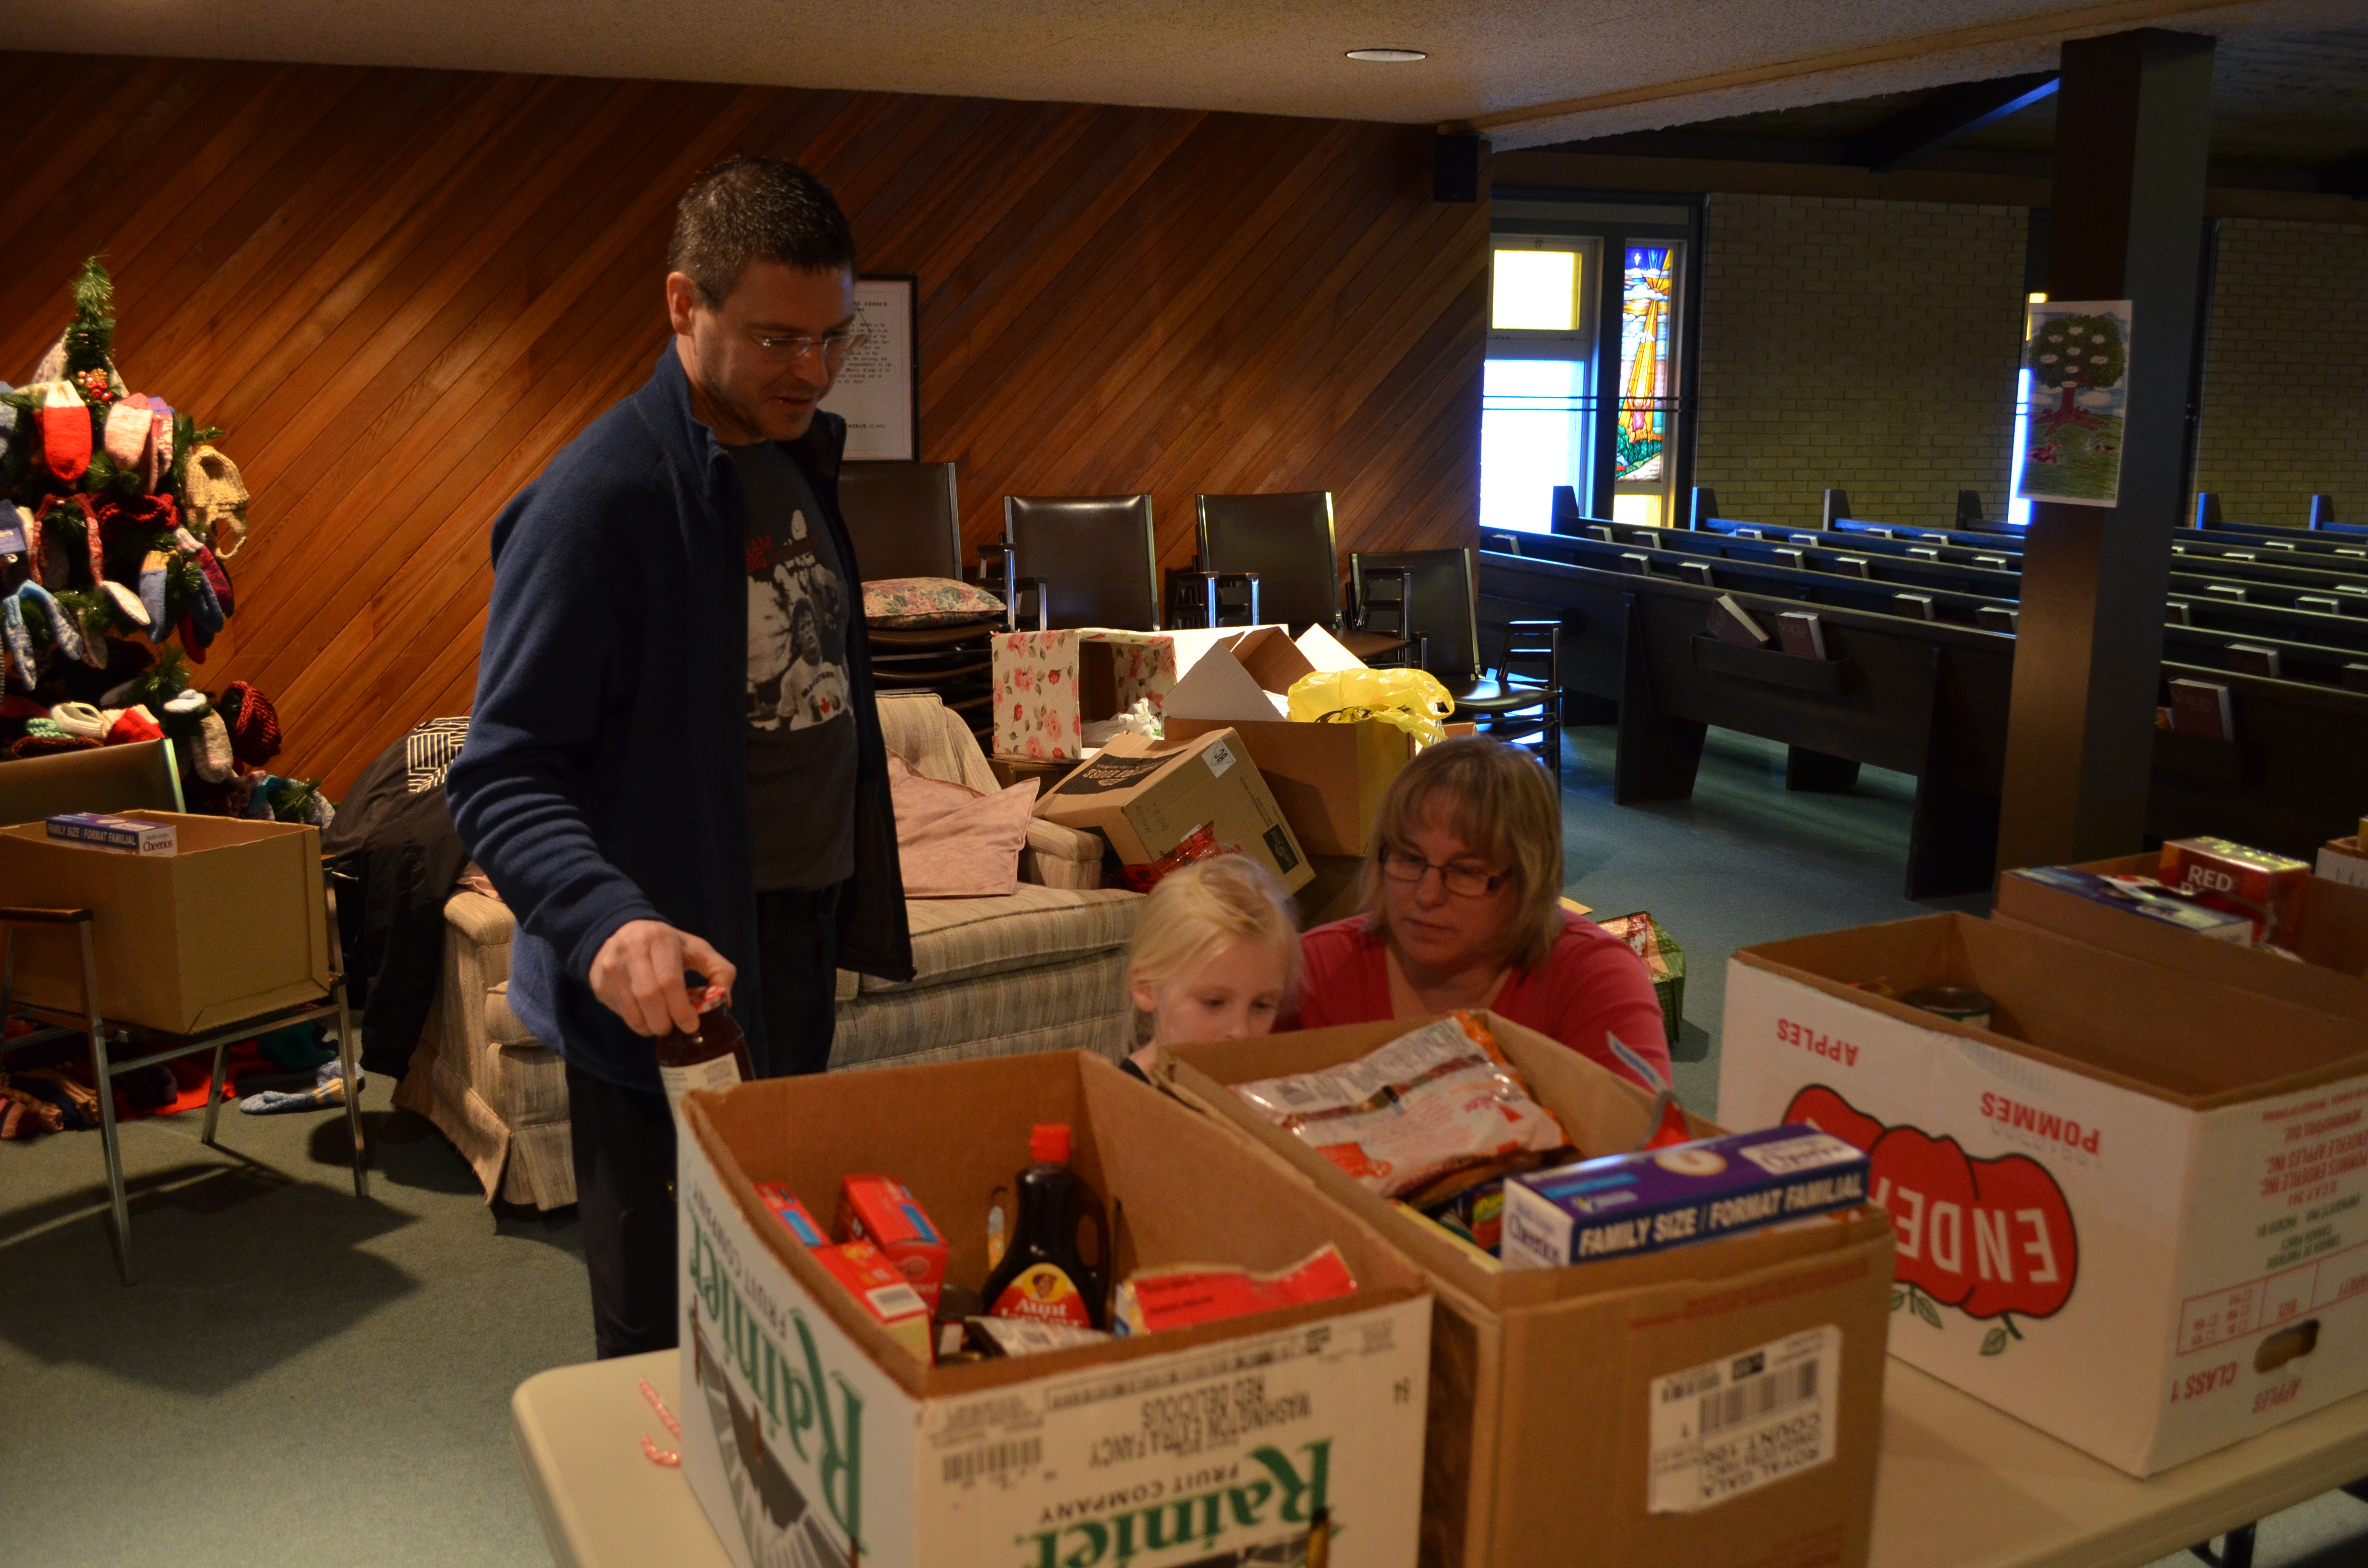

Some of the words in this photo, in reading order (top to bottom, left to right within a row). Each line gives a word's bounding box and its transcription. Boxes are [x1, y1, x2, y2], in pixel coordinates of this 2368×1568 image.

[48, 823, 67, 837] FAMILY
[67, 825, 80, 837] SIZE
[84, 830, 109, 843] FORMAT
[109, 833, 136, 846] FAMILIAL
[143, 839, 173, 852] Cheerios
[2187, 864, 2232, 892] RED
[1777, 1017, 1859, 1067] APPLES
[1981, 1090, 2100, 1155] POMMES
[1577, 1217, 1652, 1258] FAMILY
[1652, 1206, 1697, 1243] SIZE
[1709, 1188, 1785, 1231] FORMAT
[1783, 1172, 1864, 1215] FAMILIAL
[1014, 1298, 1067, 1320] Aunt
[690, 1213, 869, 1556] Rainier
[2184, 1360, 2238, 1400] CLASS
[1172, 1461, 1240, 1496] FRUIT
[1038, 1479, 1165, 1526] COMPANY
